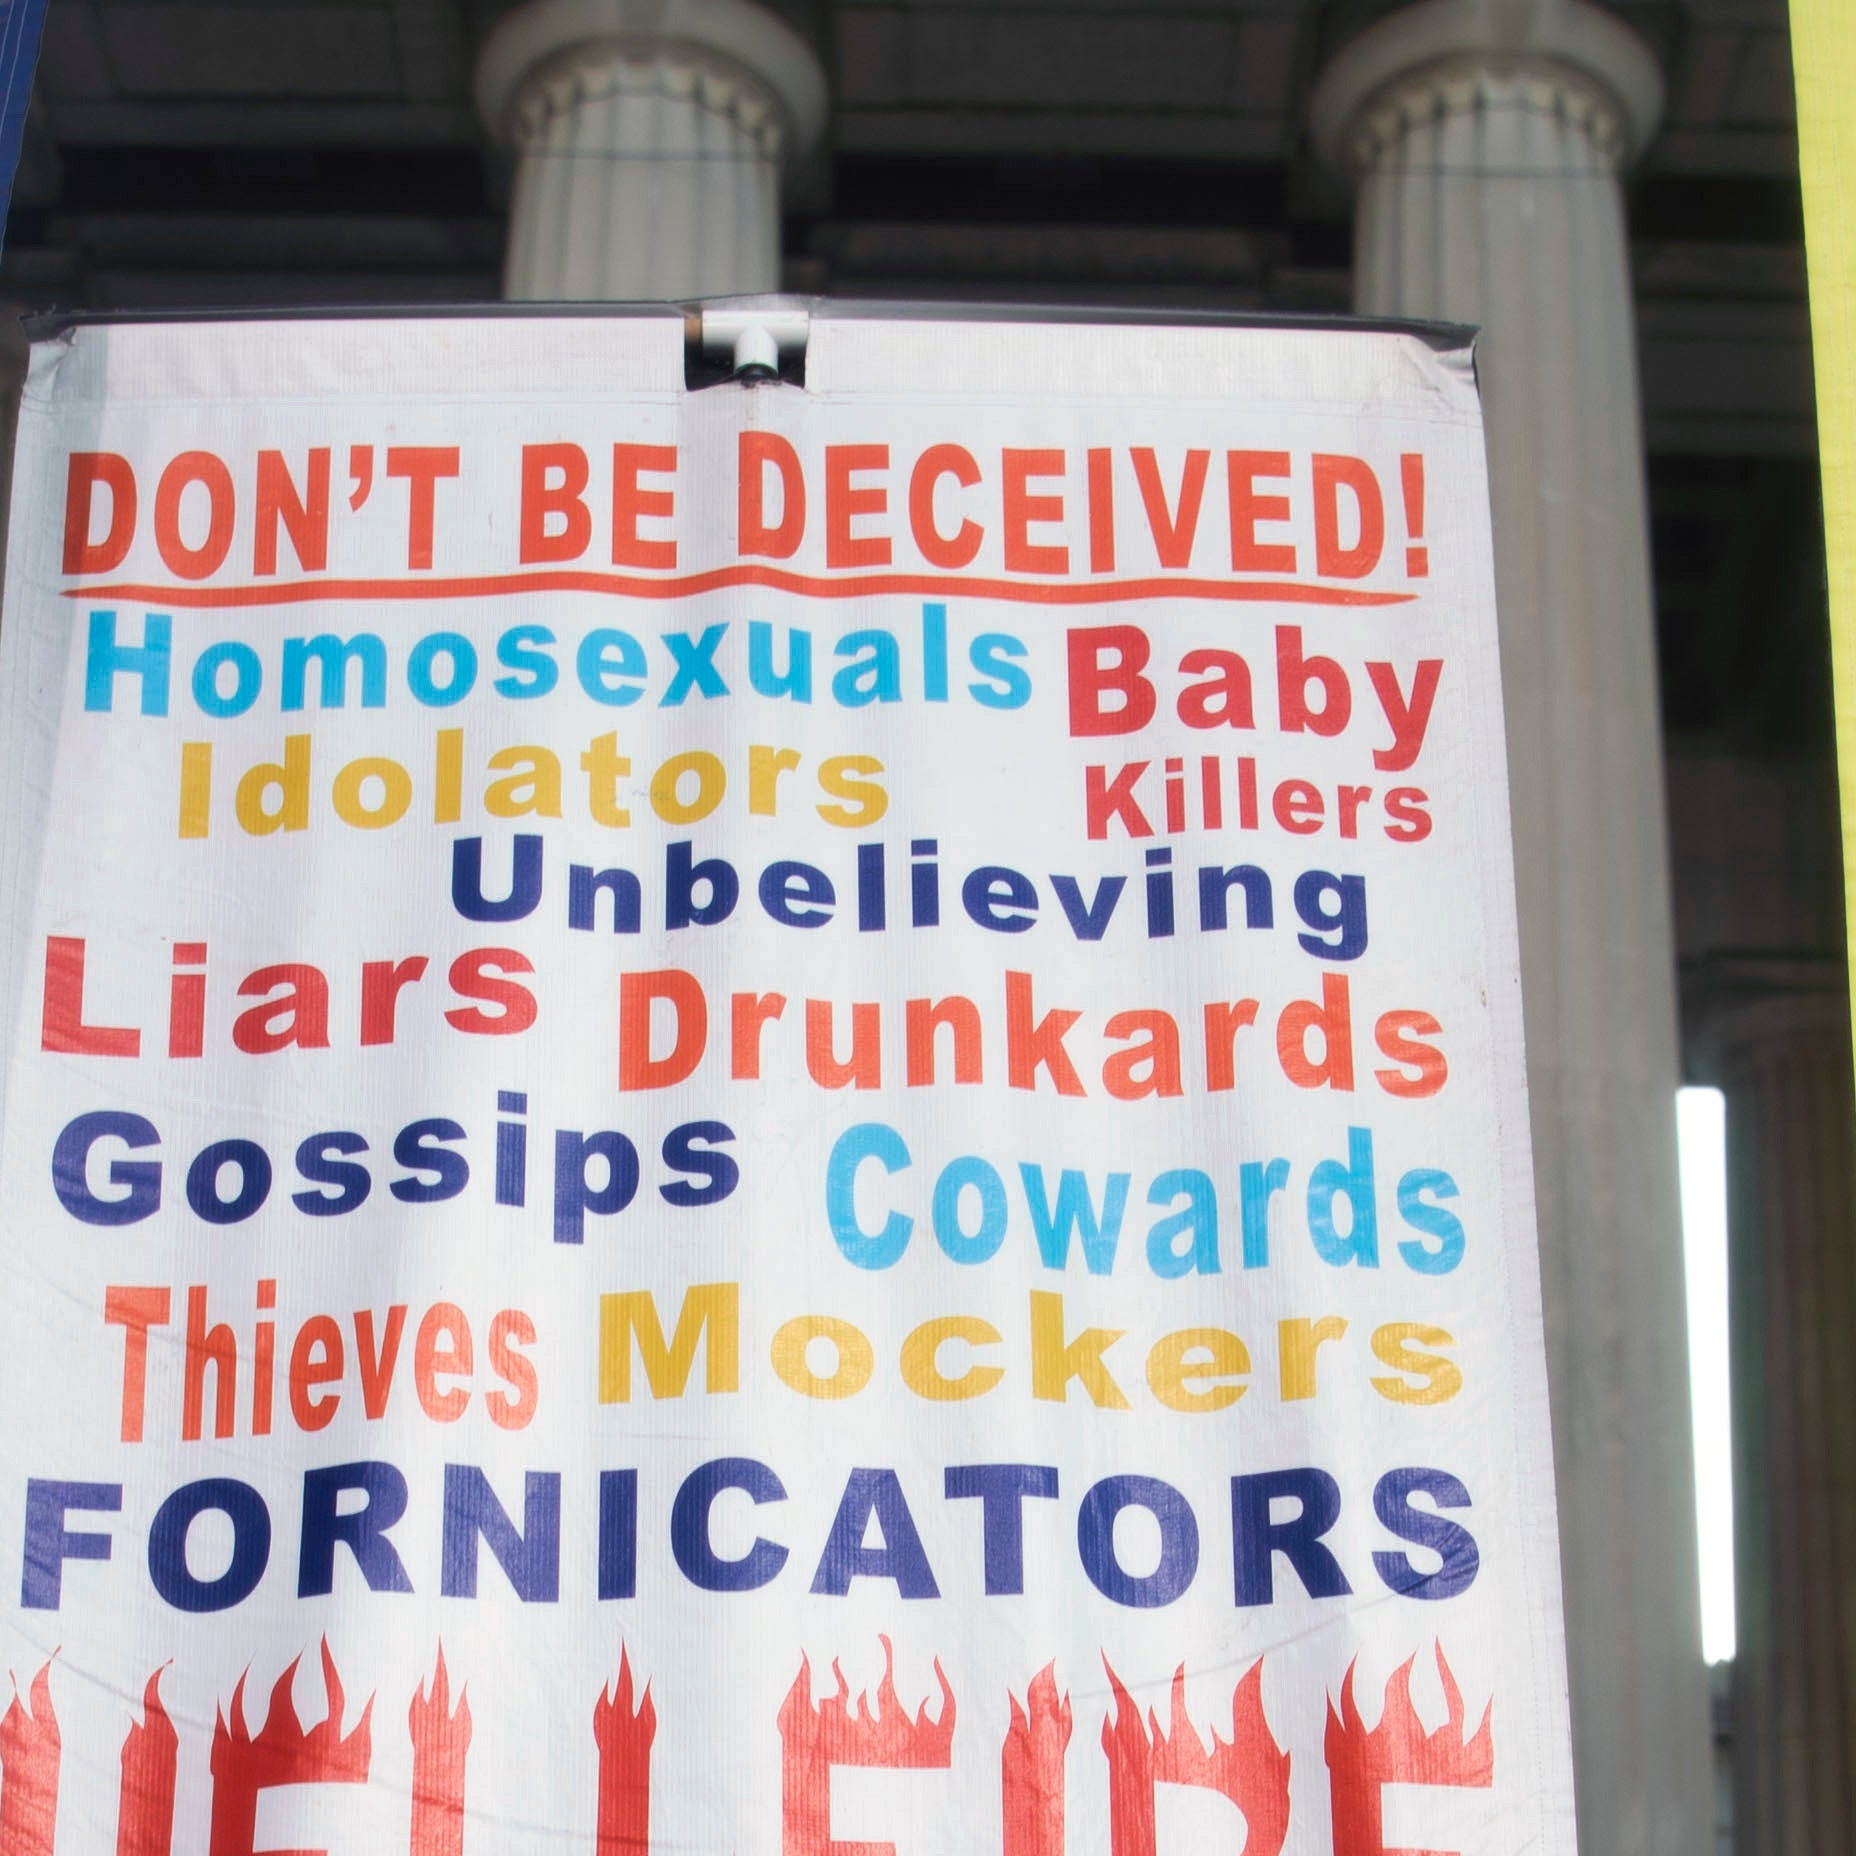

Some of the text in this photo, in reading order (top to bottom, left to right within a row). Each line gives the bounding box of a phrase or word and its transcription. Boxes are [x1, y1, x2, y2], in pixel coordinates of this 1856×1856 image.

[62, 430, 1430, 580] DON'T BE DECEIVED!
[82, 603, 1033, 718] Homosexuals
[1067, 624, 1444, 772] Baby
[178, 728, 891, 841] Idolators
[1085, 756, 1434, 844] Killers
[451, 834, 1369, 961] Unbelieving
[41, 936, 539, 1059] Liars
[619, 969, 1449, 1100] Drunkards
[51, 1089, 741, 1244] Gossips
[826, 1123, 1465, 1279] Cowards
[105, 1279, 537, 1443] Thieves
[599, 1282, 1463, 1412] Mockers
[20, 1457, 1479, 1613] FORNICATORS
